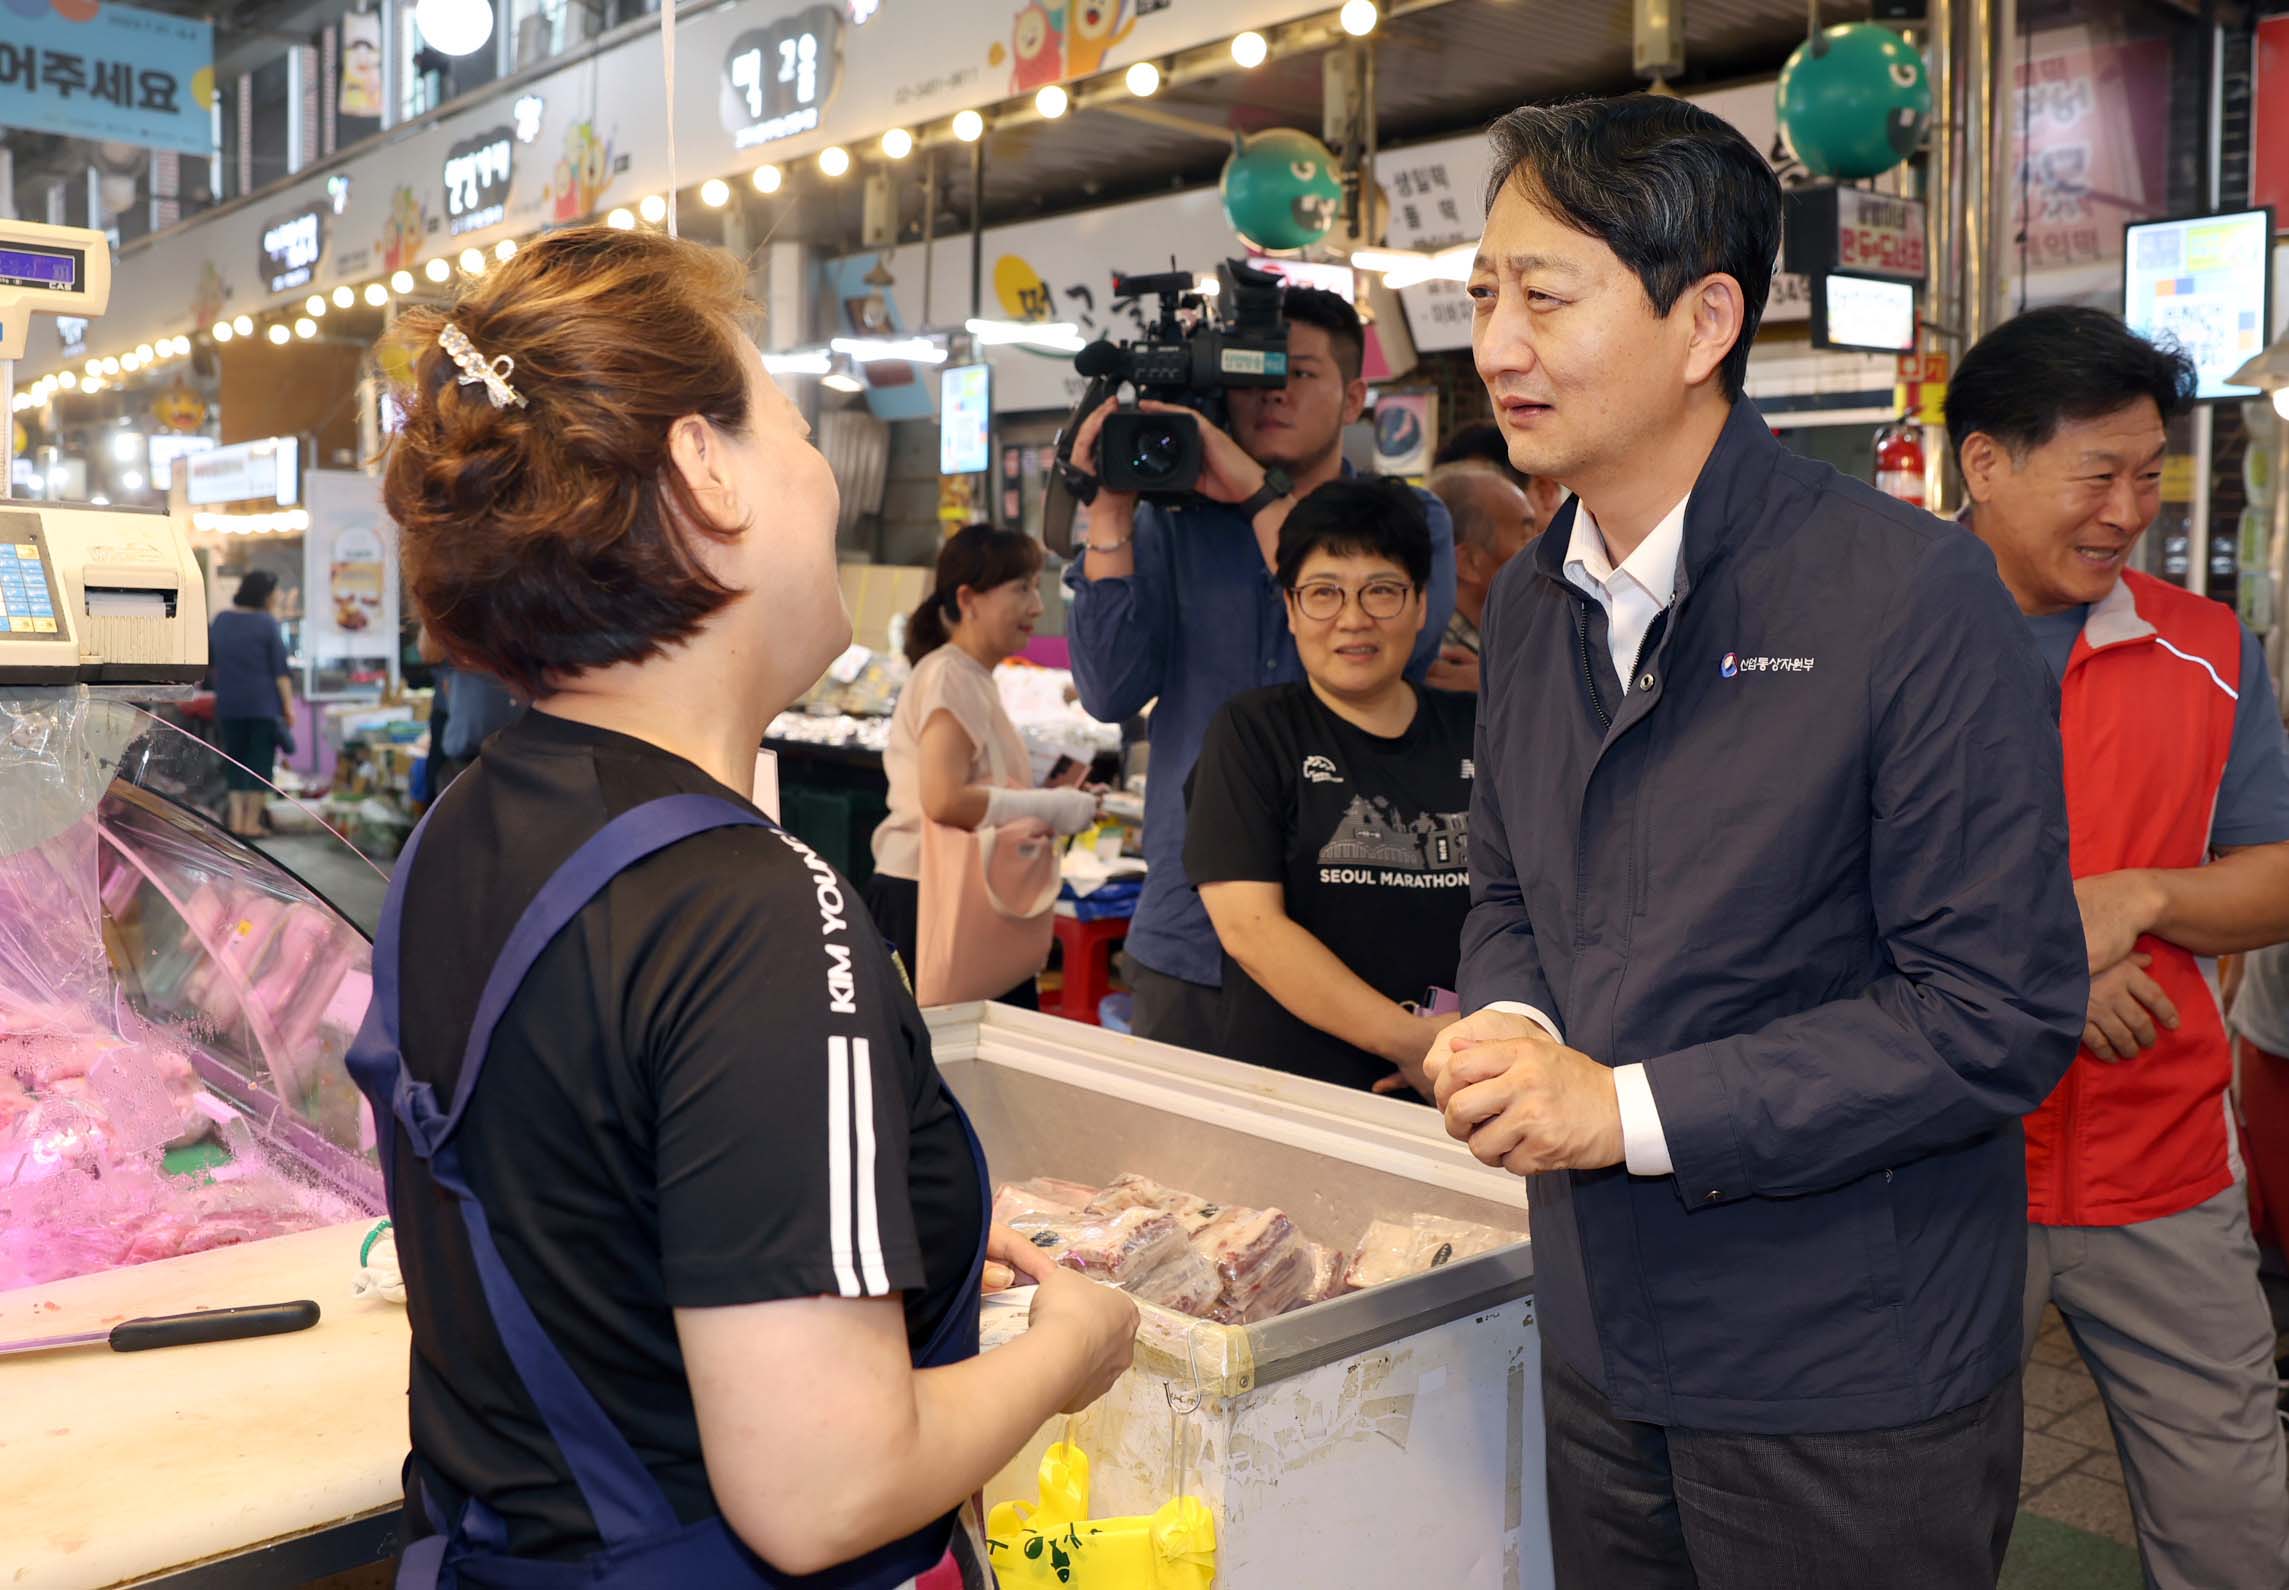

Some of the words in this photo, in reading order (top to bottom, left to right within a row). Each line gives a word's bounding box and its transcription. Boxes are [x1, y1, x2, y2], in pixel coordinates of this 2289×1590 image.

[1740, 656, 1815, 672] 산업통상자원부
[1319, 868, 1376, 886] SEOUL
[1379, 871, 1470, 889] MARATHON
[824, 943, 856, 1014] KIM
